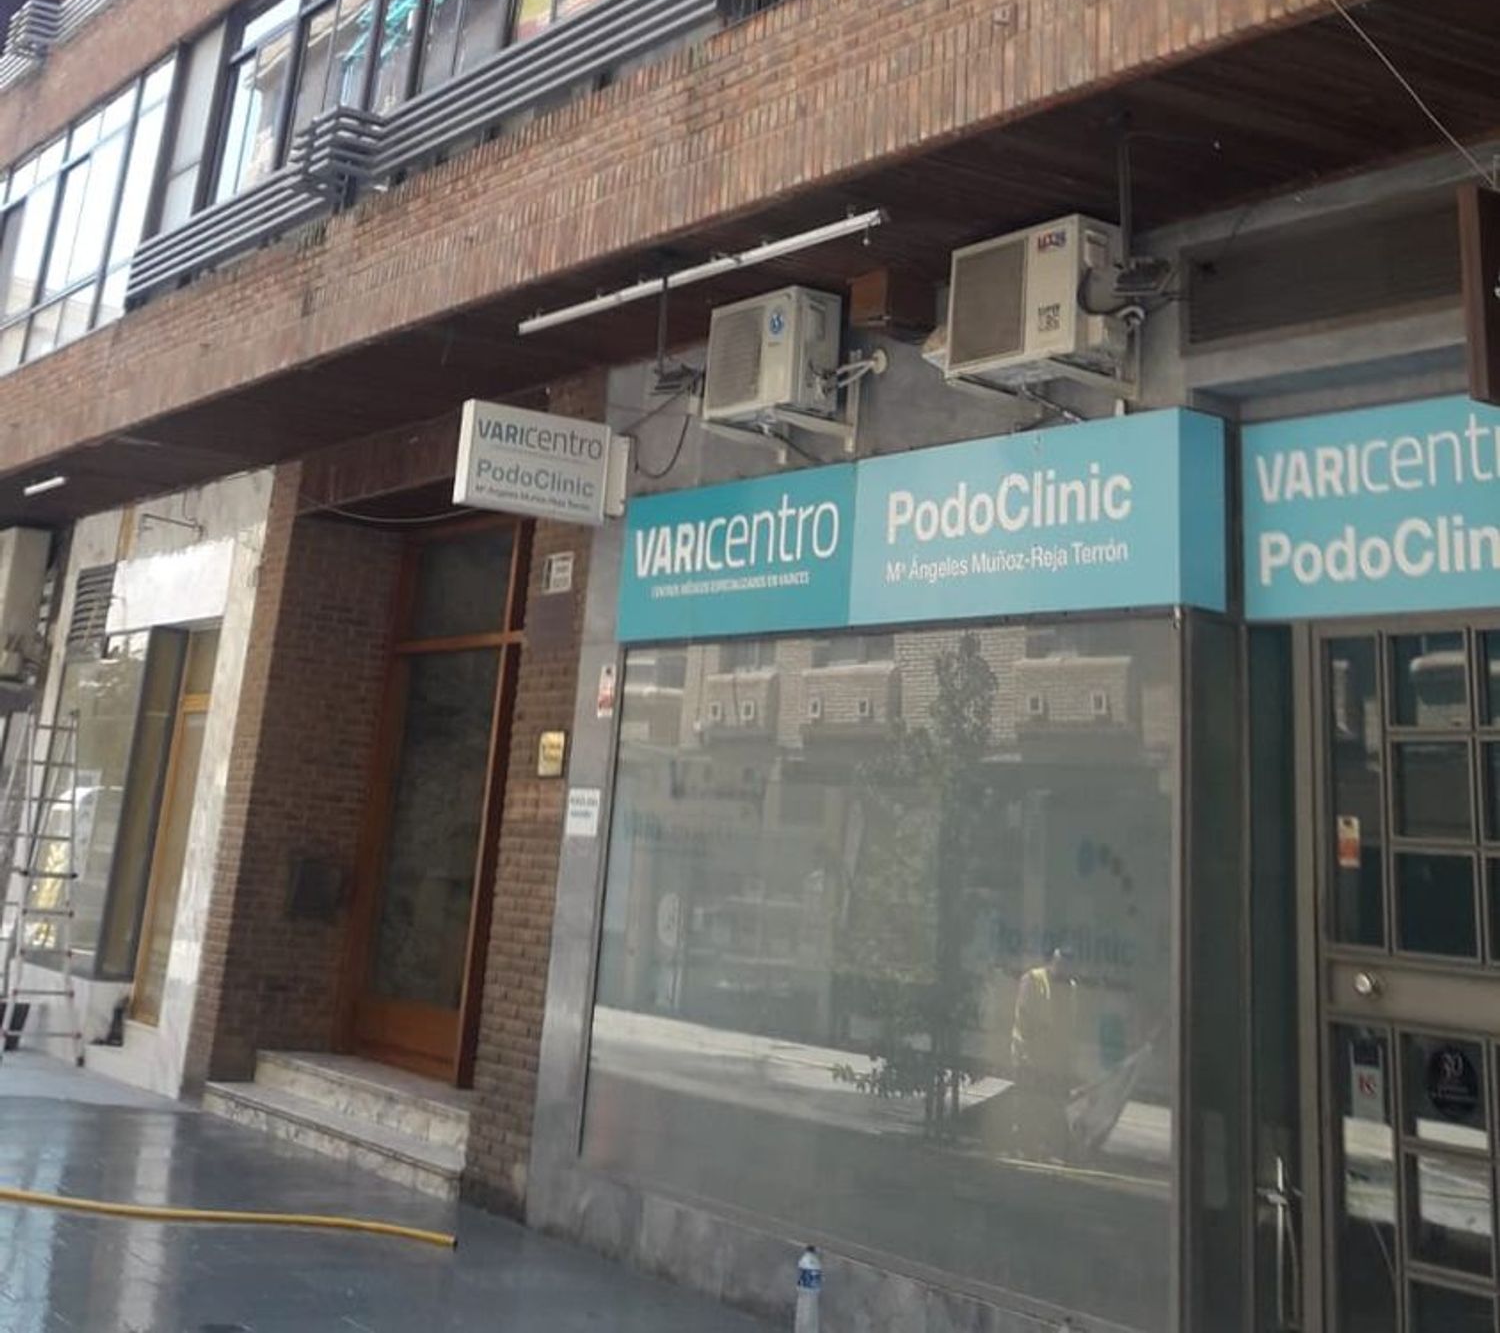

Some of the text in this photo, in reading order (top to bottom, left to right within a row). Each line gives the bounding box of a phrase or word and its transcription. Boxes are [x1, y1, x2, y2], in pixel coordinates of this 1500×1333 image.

[476, 458, 595, 498] PodoClinic
[1256, 412, 1500, 504] VARIcent
[635, 493, 840, 579] VARIcentro
[886, 462, 1133, 545] PodoClinic
[908, 554, 969, 584] Ángeles
[1071, 537, 1130, 565] Terrón
[1259, 514, 1500, 587] PodoClin
